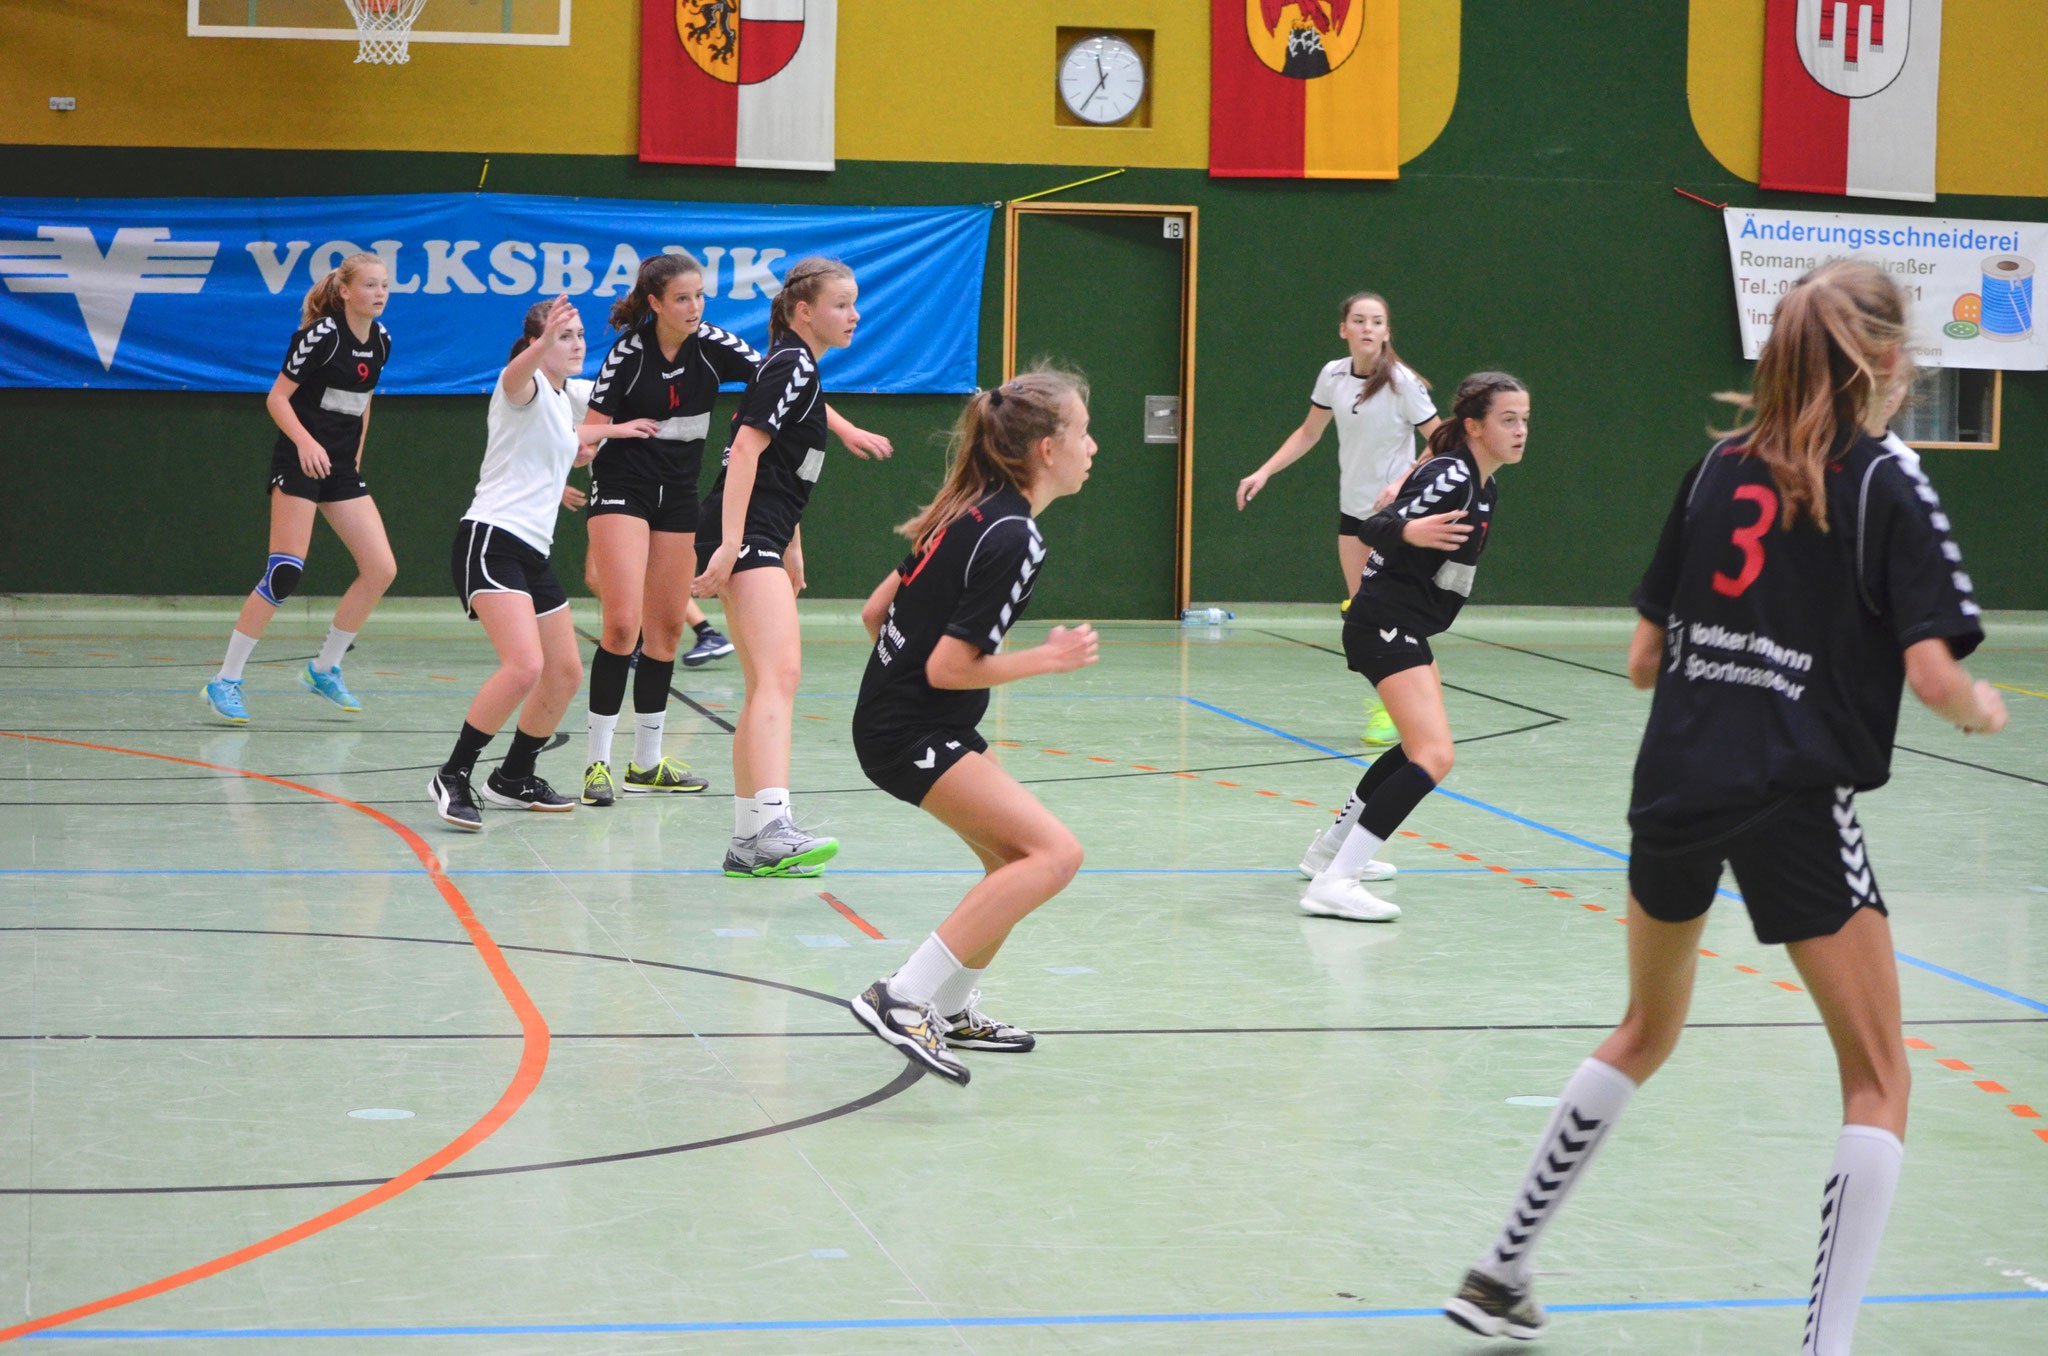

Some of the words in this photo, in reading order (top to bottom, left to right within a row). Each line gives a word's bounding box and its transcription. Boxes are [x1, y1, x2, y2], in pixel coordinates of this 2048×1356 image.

[1167, 222, 1180, 238] 1B
[1740, 213, 2019, 252] Änderungsschneiderei
[1740, 250, 1816, 270] Romana
[357, 362, 370, 383] 9
[1711, 484, 1779, 598] 3
